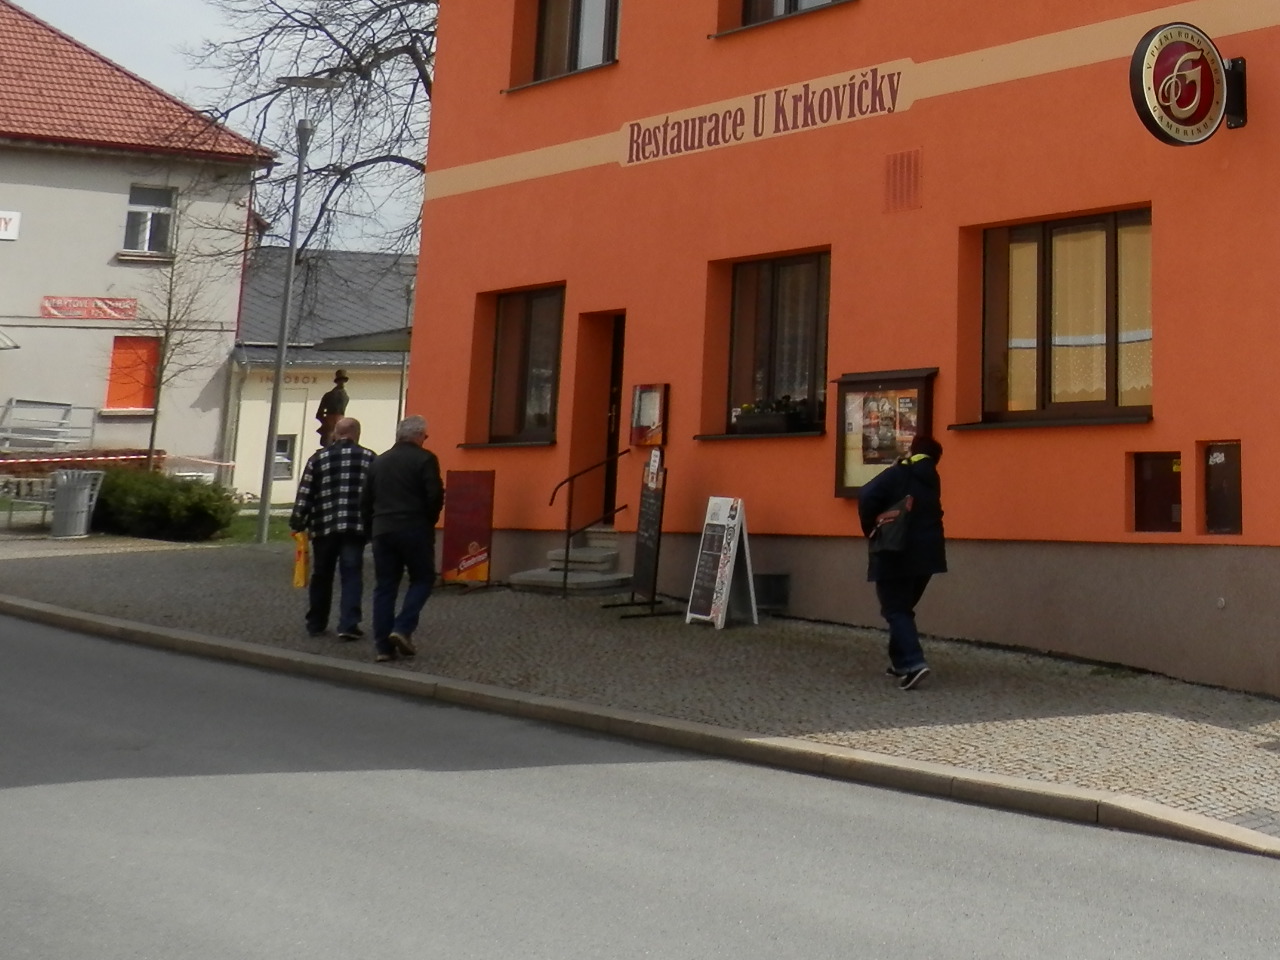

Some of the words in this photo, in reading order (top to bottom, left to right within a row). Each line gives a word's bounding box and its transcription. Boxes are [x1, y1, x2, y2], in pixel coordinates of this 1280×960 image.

[627, 106, 745, 164] Restaurace
[753, 93, 767, 138] U
[773, 68, 901, 133] Krkovíčky
[260, 375, 318, 385] INOBOX
